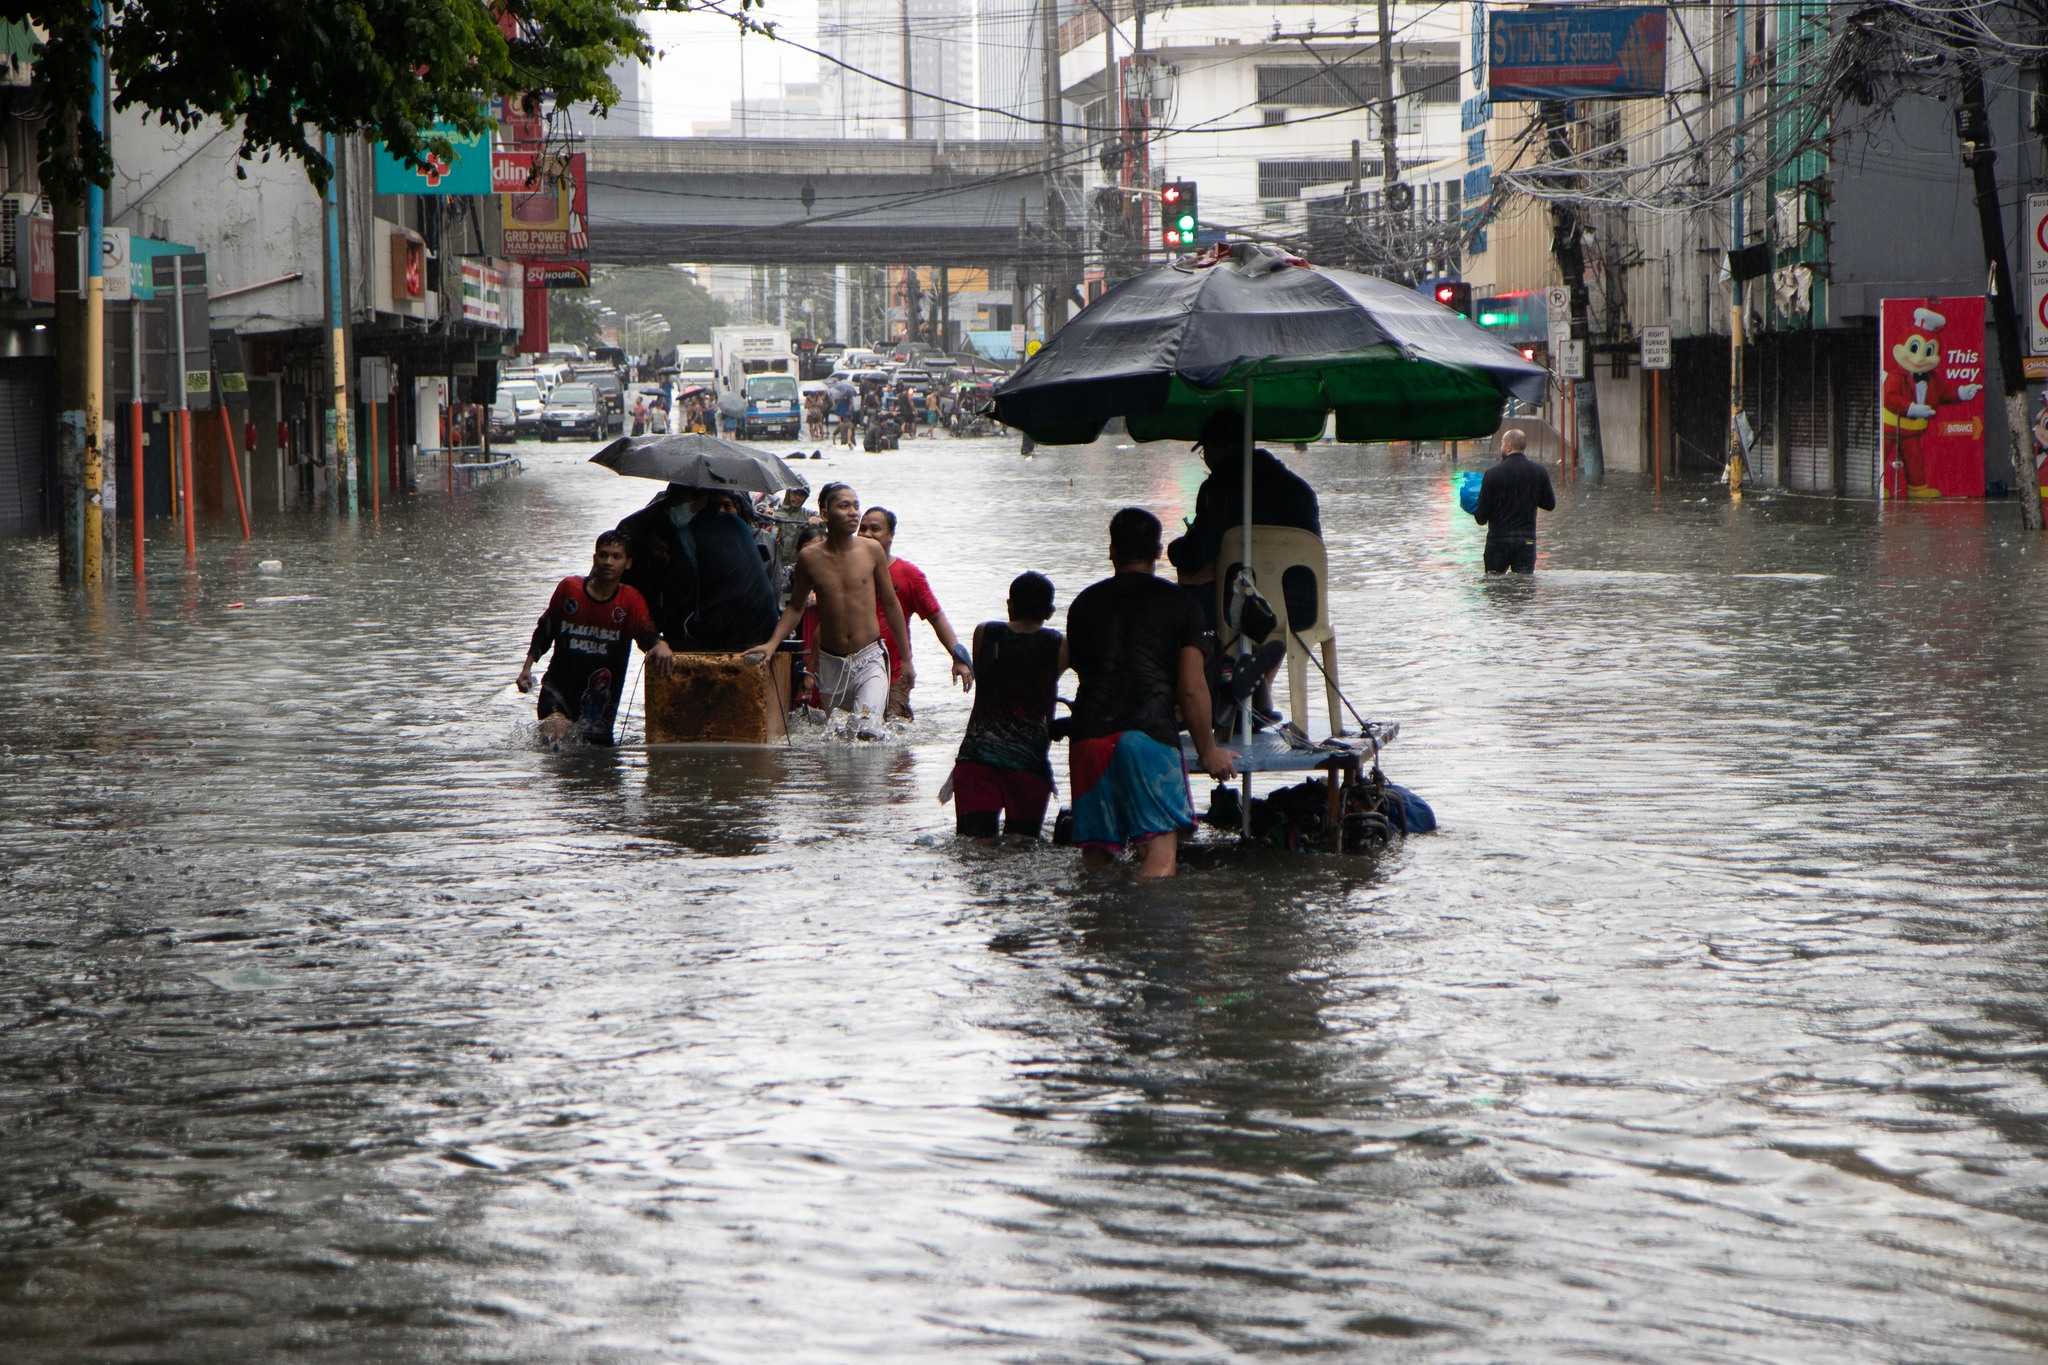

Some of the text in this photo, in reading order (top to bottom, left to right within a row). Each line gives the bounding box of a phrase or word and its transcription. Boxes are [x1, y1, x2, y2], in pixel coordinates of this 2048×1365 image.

[493, 159, 535, 182] dlin
[504, 231, 566, 243] GRID POWER
[507, 242, 565, 250] HARDWARE
[545, 271, 576, 280] HOURS
[1947, 349, 1979, 364] This
[1946, 367, 1980, 382] way
